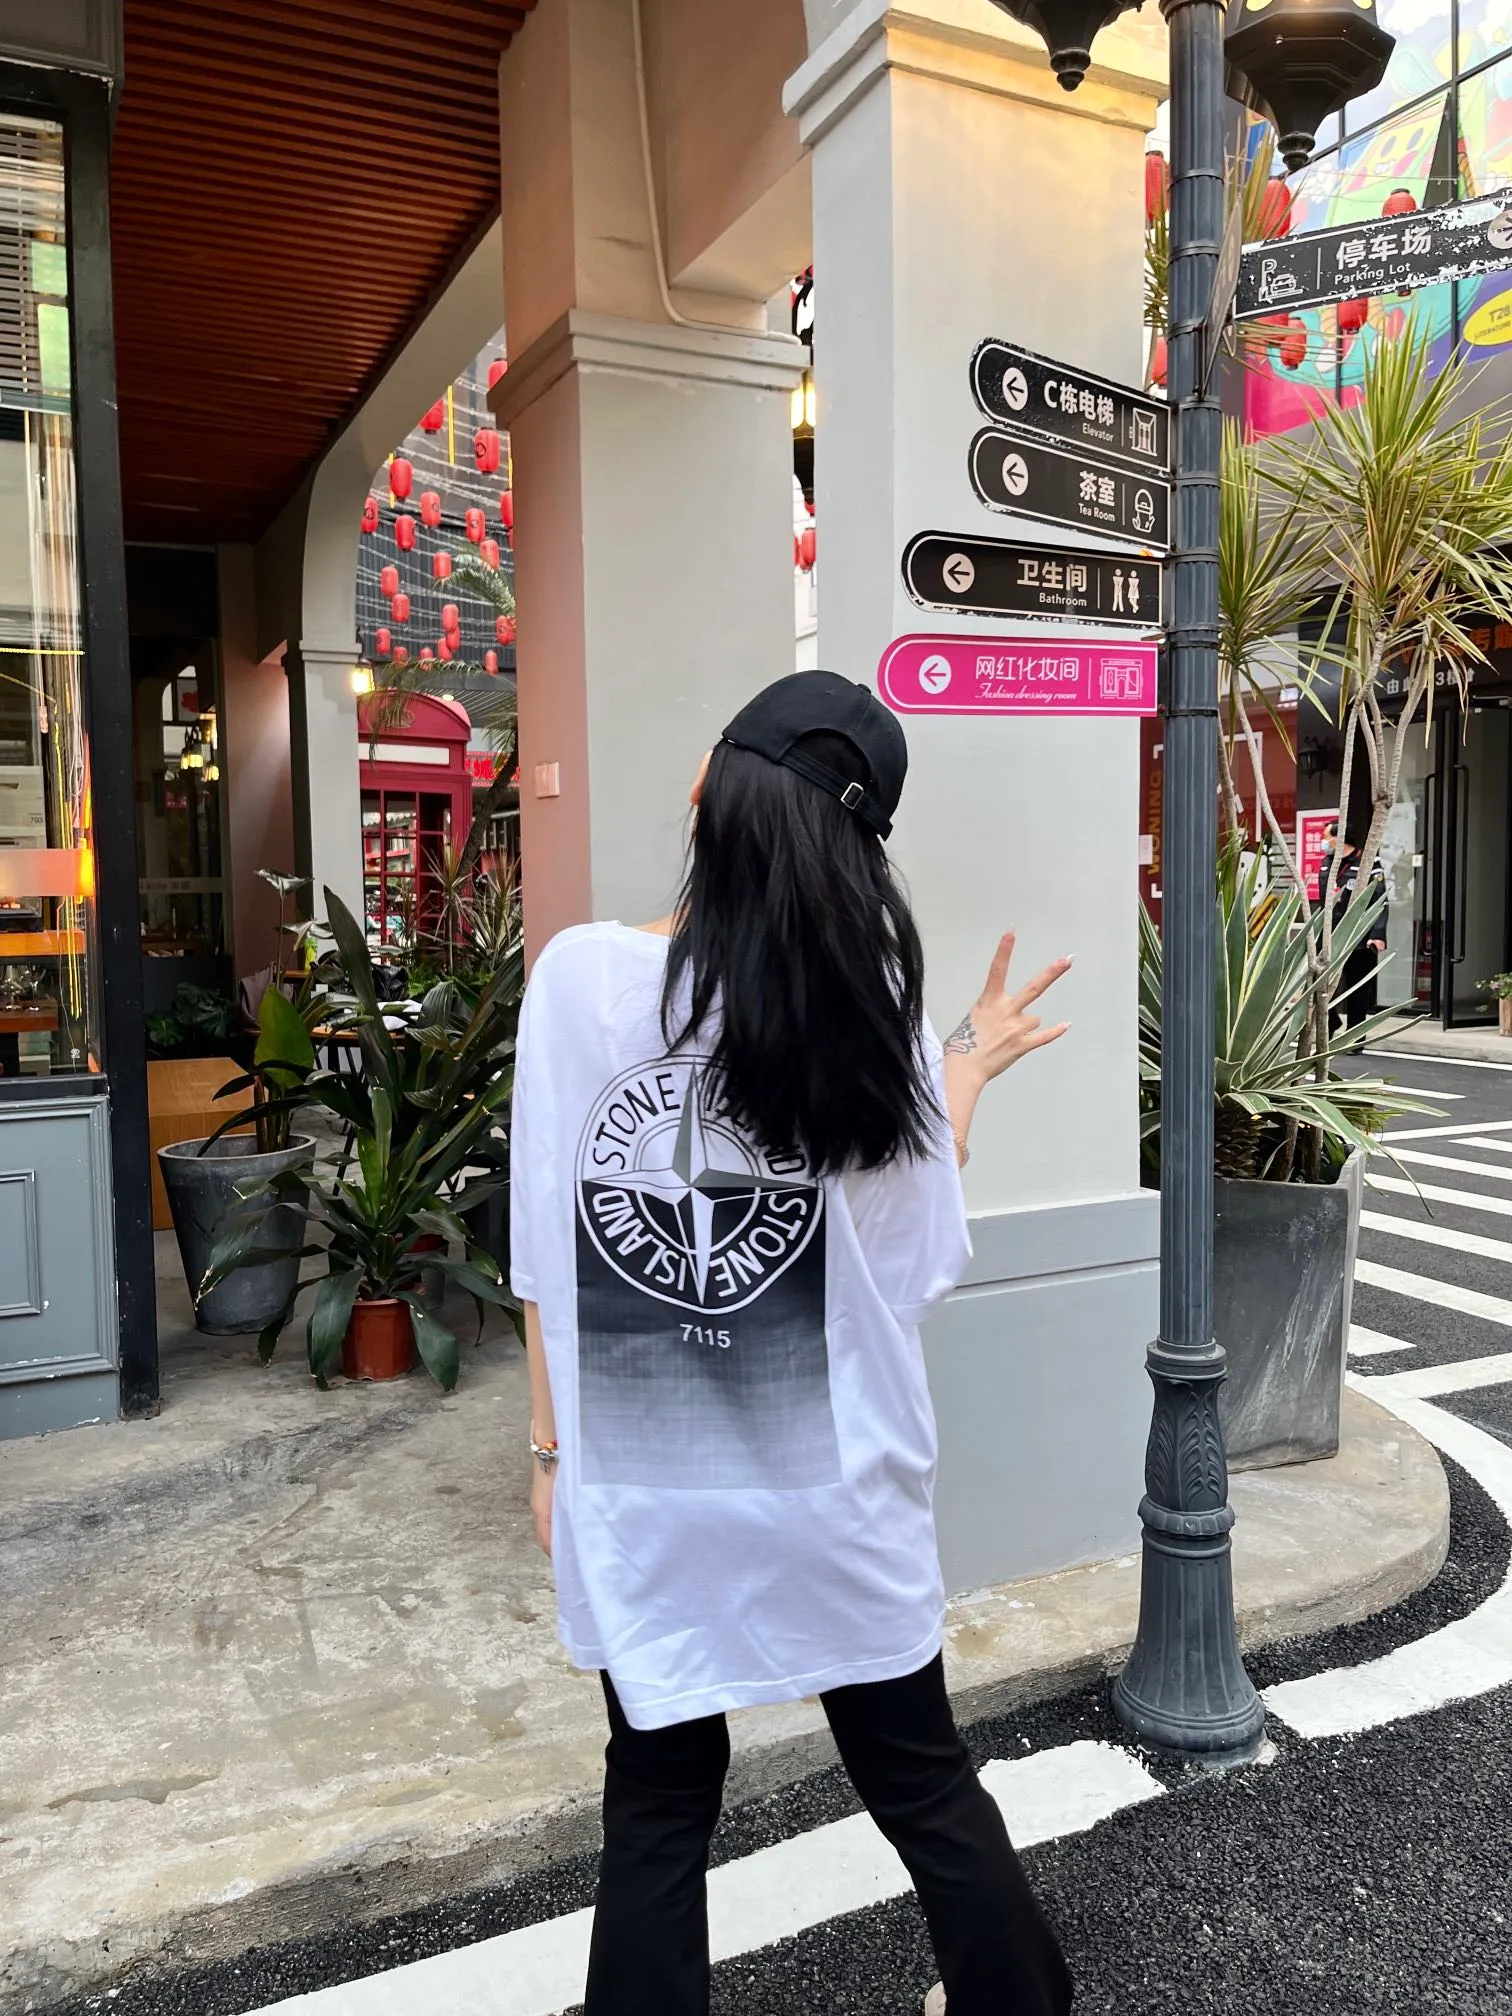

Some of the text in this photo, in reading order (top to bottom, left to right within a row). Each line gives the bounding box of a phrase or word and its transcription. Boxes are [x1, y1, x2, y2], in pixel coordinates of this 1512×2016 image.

[1335, 226, 1432, 270] 停车场
[1334, 262, 1411, 285] Parking Lot
[1044, 380, 1114, 427] C栋电梯
[1082, 422, 1113, 442] Elevator
[1079, 470, 1115, 507] 茶室
[1078, 502, 1115, 522] Tea Room
[1016, 558, 1087, 592] 卫生间
[1039, 592, 1087, 607] Bathroom
[975, 655, 1079, 681] 网红化妆间
[975, 682, 1077, 703] Fashion dressing room
[593, 1072, 681, 1171] STONE
[592, 1189, 808, 1297] STONE ISLAND
[680, 1323, 731, 1349] 7115
